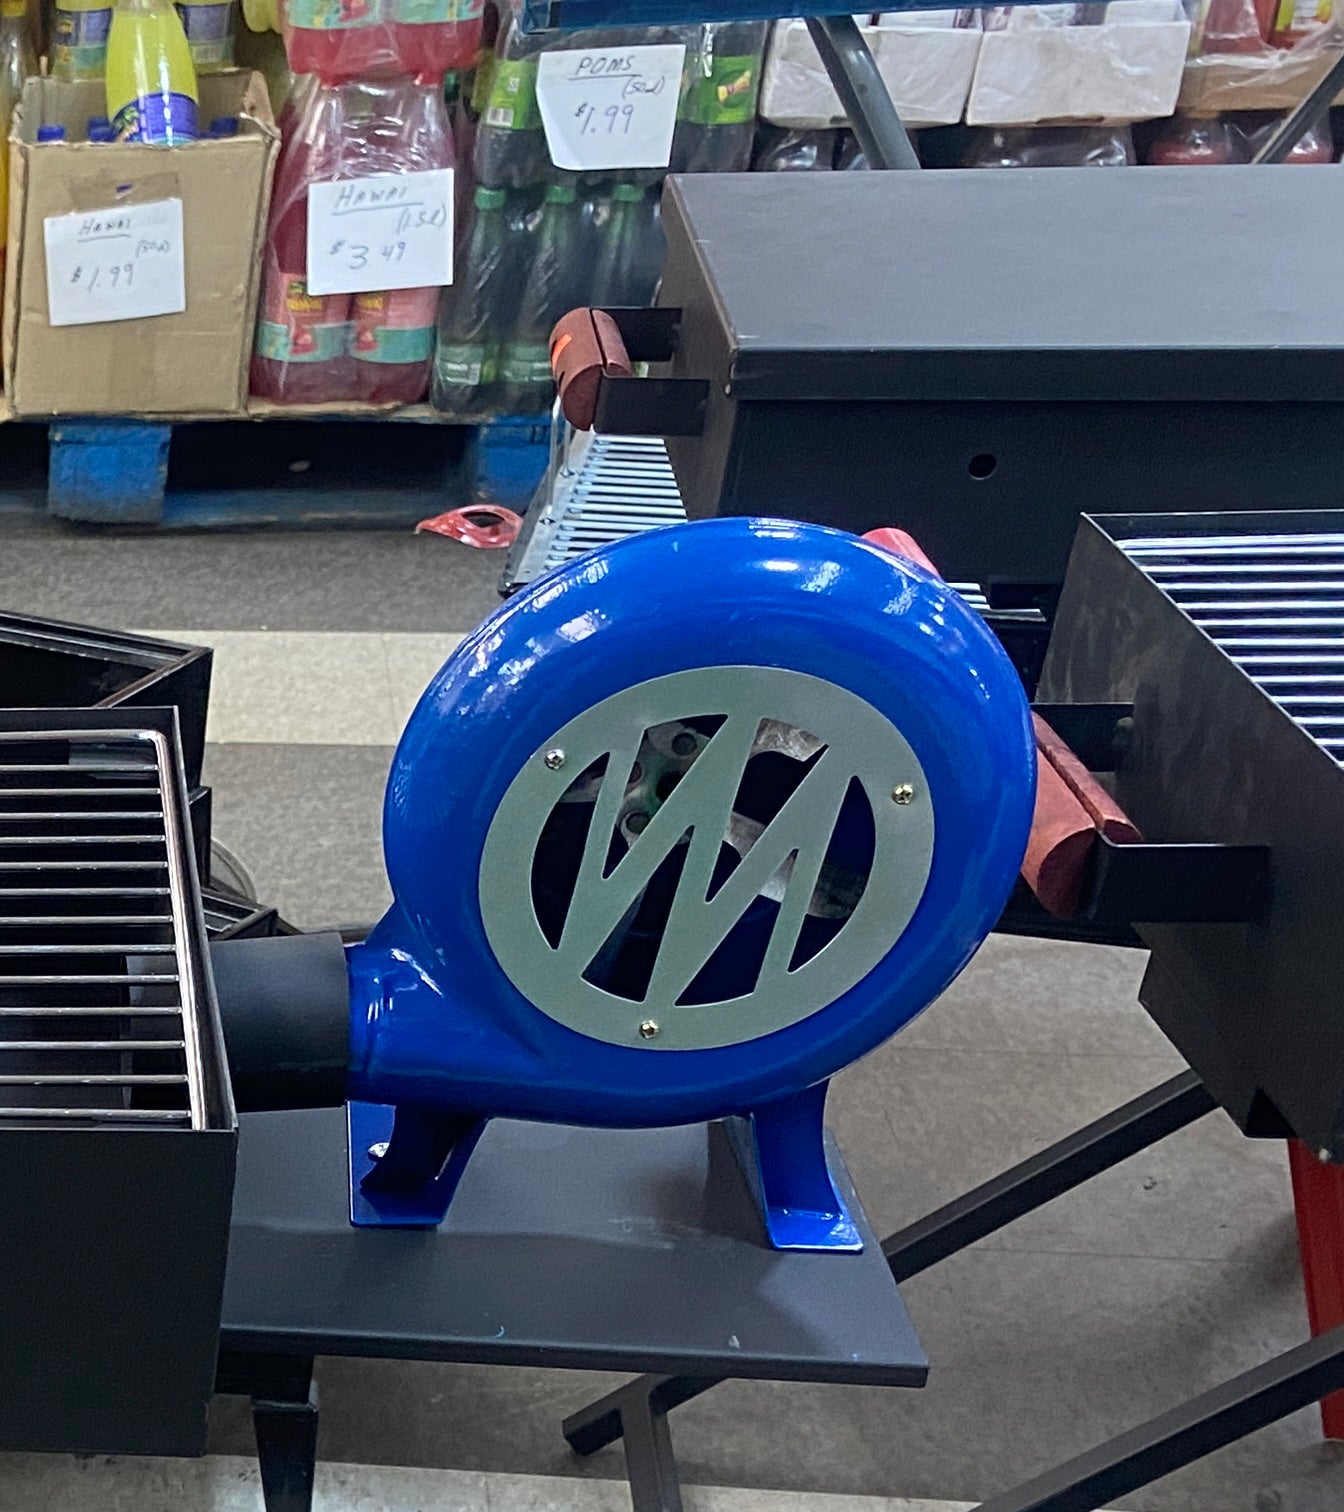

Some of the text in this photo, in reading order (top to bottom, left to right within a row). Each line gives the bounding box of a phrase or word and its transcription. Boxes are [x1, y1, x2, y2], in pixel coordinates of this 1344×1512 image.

[575, 55, 636, 75] POMS
[574, 102, 635, 135] $1.99
[71, 264, 134, 293] $1.99
